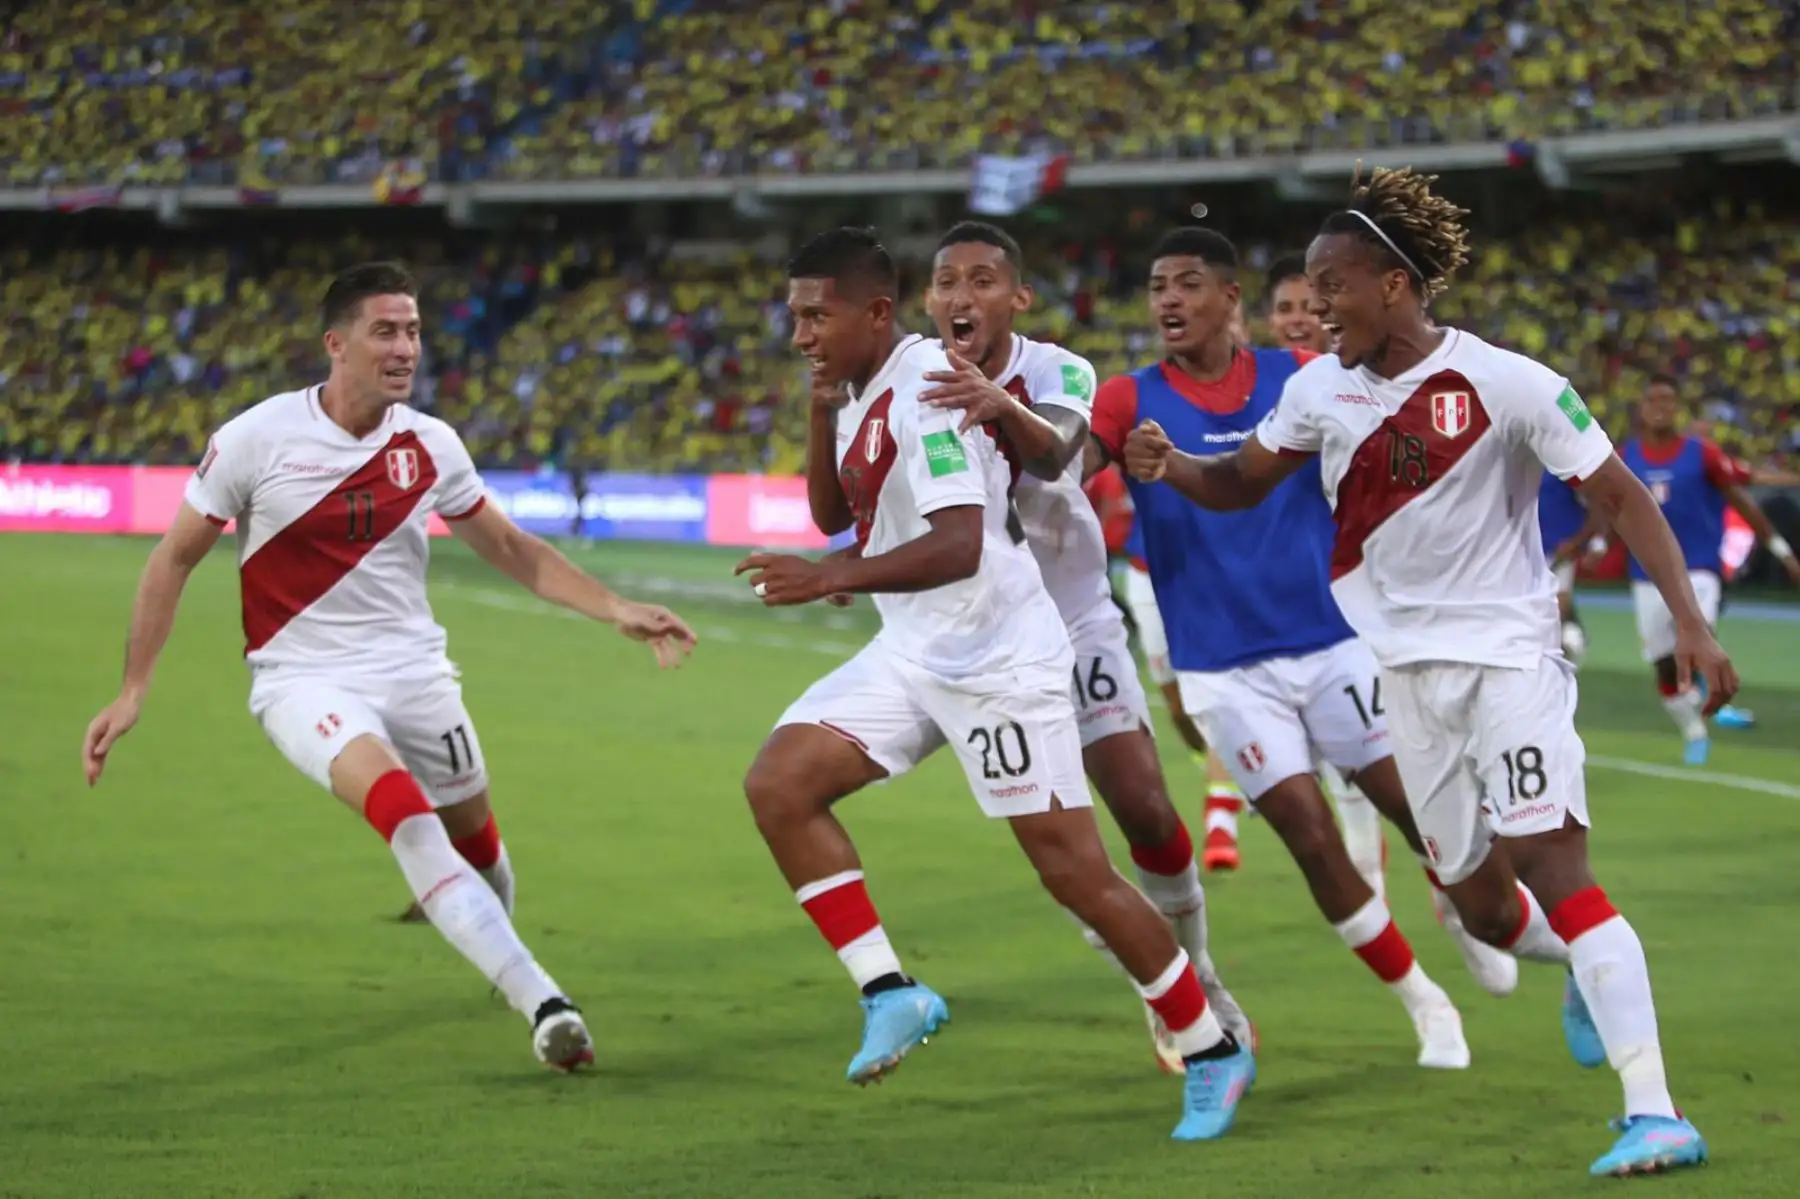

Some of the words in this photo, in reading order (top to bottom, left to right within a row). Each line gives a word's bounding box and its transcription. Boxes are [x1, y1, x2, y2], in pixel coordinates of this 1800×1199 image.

[1387, 425, 1428, 488] 18
[341, 489, 374, 541] 11
[1072, 656, 1118, 710] 16
[441, 724, 474, 776] 11
[967, 720, 1032, 779] 20
[1501, 746, 1548, 806] 18
